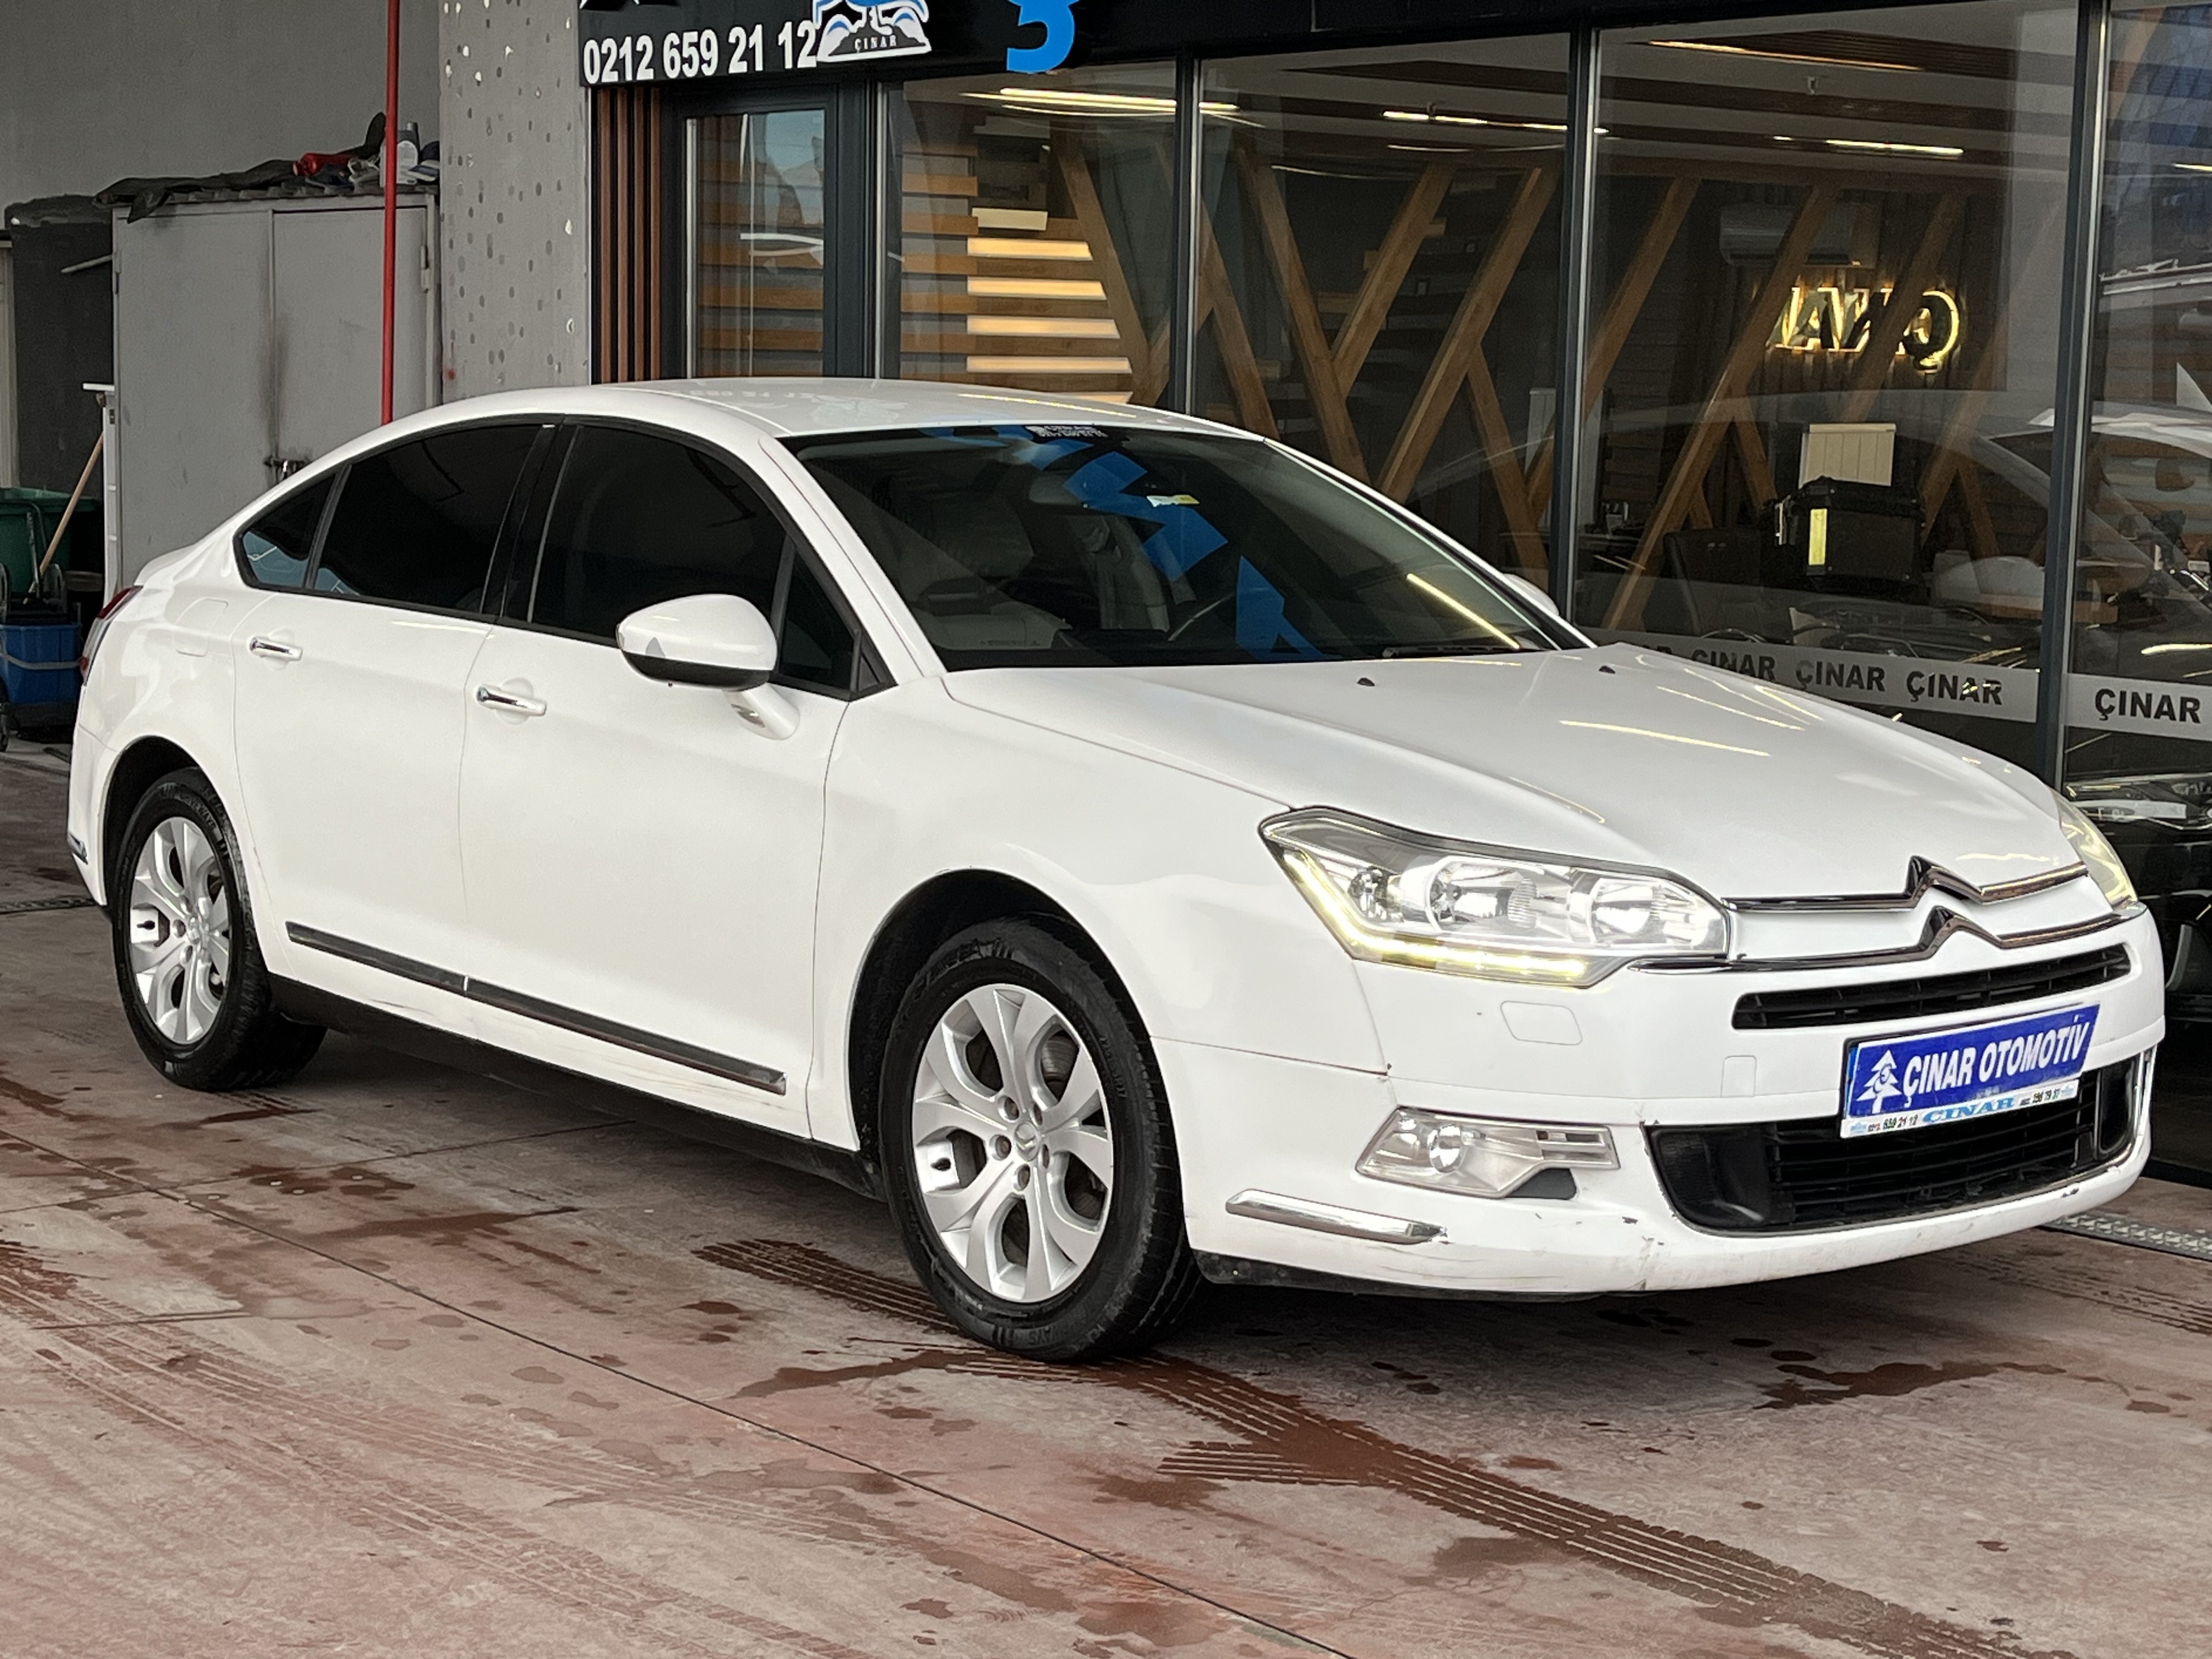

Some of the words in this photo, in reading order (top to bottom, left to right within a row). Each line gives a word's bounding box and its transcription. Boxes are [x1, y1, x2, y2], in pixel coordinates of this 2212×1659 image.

[584, 35, 654, 84] 0212
[663, 29, 719, 79] 659
[728, 24, 763, 74] 21
[778, 20, 817, 69] 12
[855, 35, 897, 53] ÇINAR
[1795, 659, 1886, 692] ÇINAR
[1906, 670, 2002, 706] ÇINAR
[2095, 689, 2201, 724] ÇINAR
[1903, 1047, 1976, 1108] ÇINAR
[1978, 1015, 2090, 1082] OTOMOTİV
